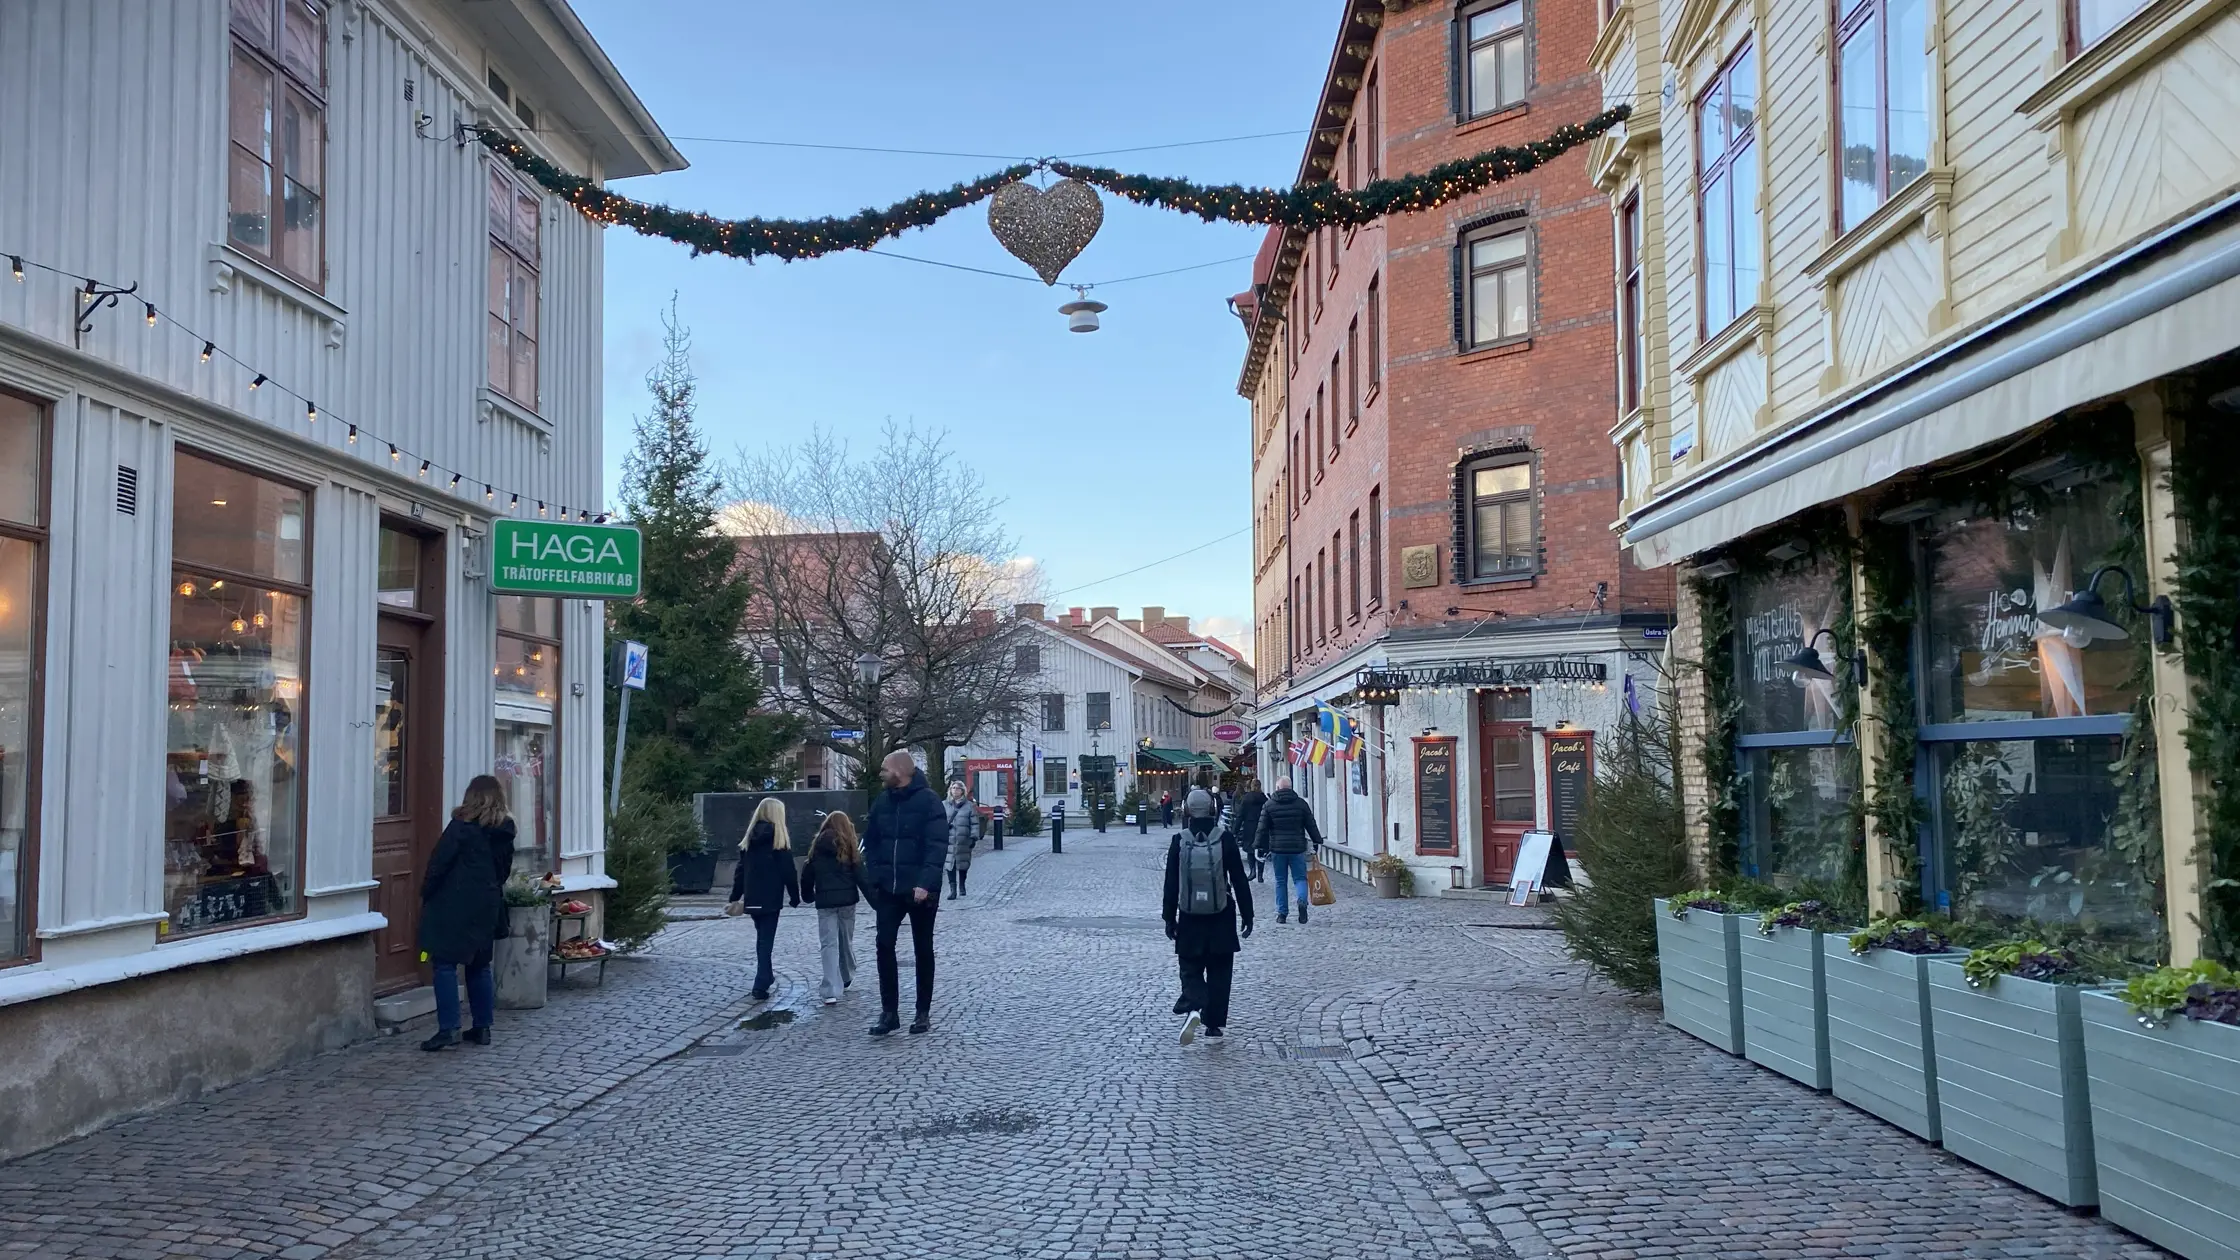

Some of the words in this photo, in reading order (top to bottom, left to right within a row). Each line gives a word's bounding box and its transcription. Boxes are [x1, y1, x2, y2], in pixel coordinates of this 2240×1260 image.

[511, 531, 624, 565] HAGA
[502, 564, 615, 585] TRÄTOFFELFABRIK
[617, 573, 633, 587] AB
[1419, 746, 1450, 760] Jacob's
[1550, 741, 1586, 756] Jacob's
[1557, 760, 1581, 774] Café
